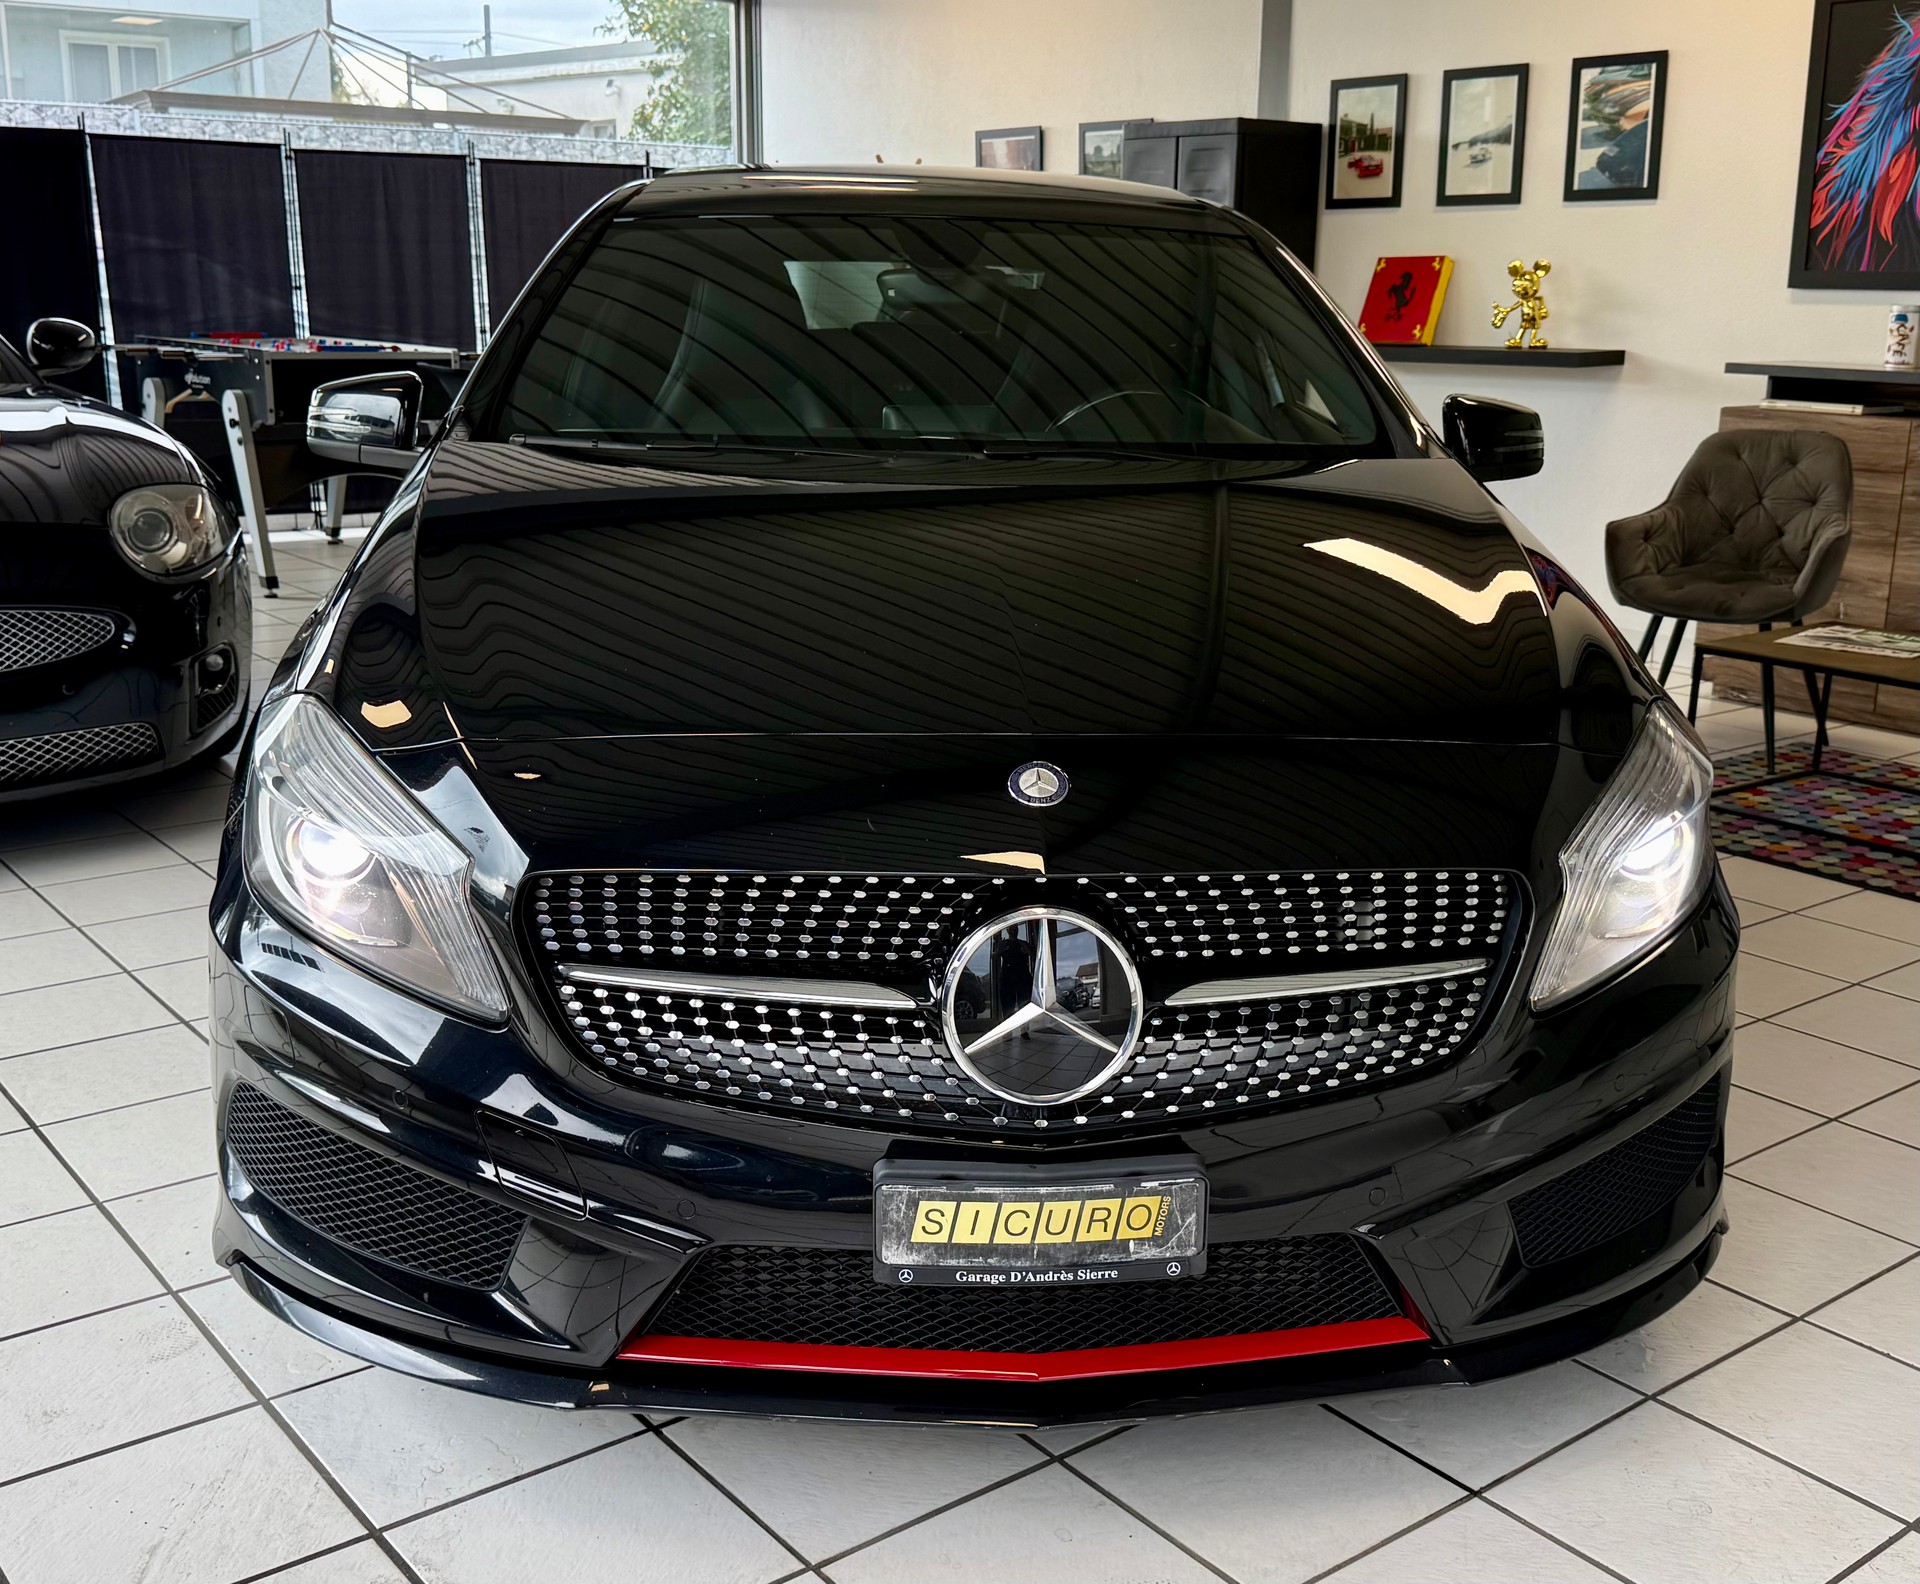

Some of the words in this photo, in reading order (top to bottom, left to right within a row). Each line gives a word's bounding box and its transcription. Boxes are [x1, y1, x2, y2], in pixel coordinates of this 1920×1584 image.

[921, 1203, 1153, 1237] SICURO
[1154, 1196, 1172, 1236] MOTORS
[955, 1270, 1007, 1285] Garage
[1010, 1269, 1073, 1283] D'Andrès
[1077, 1268, 1119, 1281] Sierre
